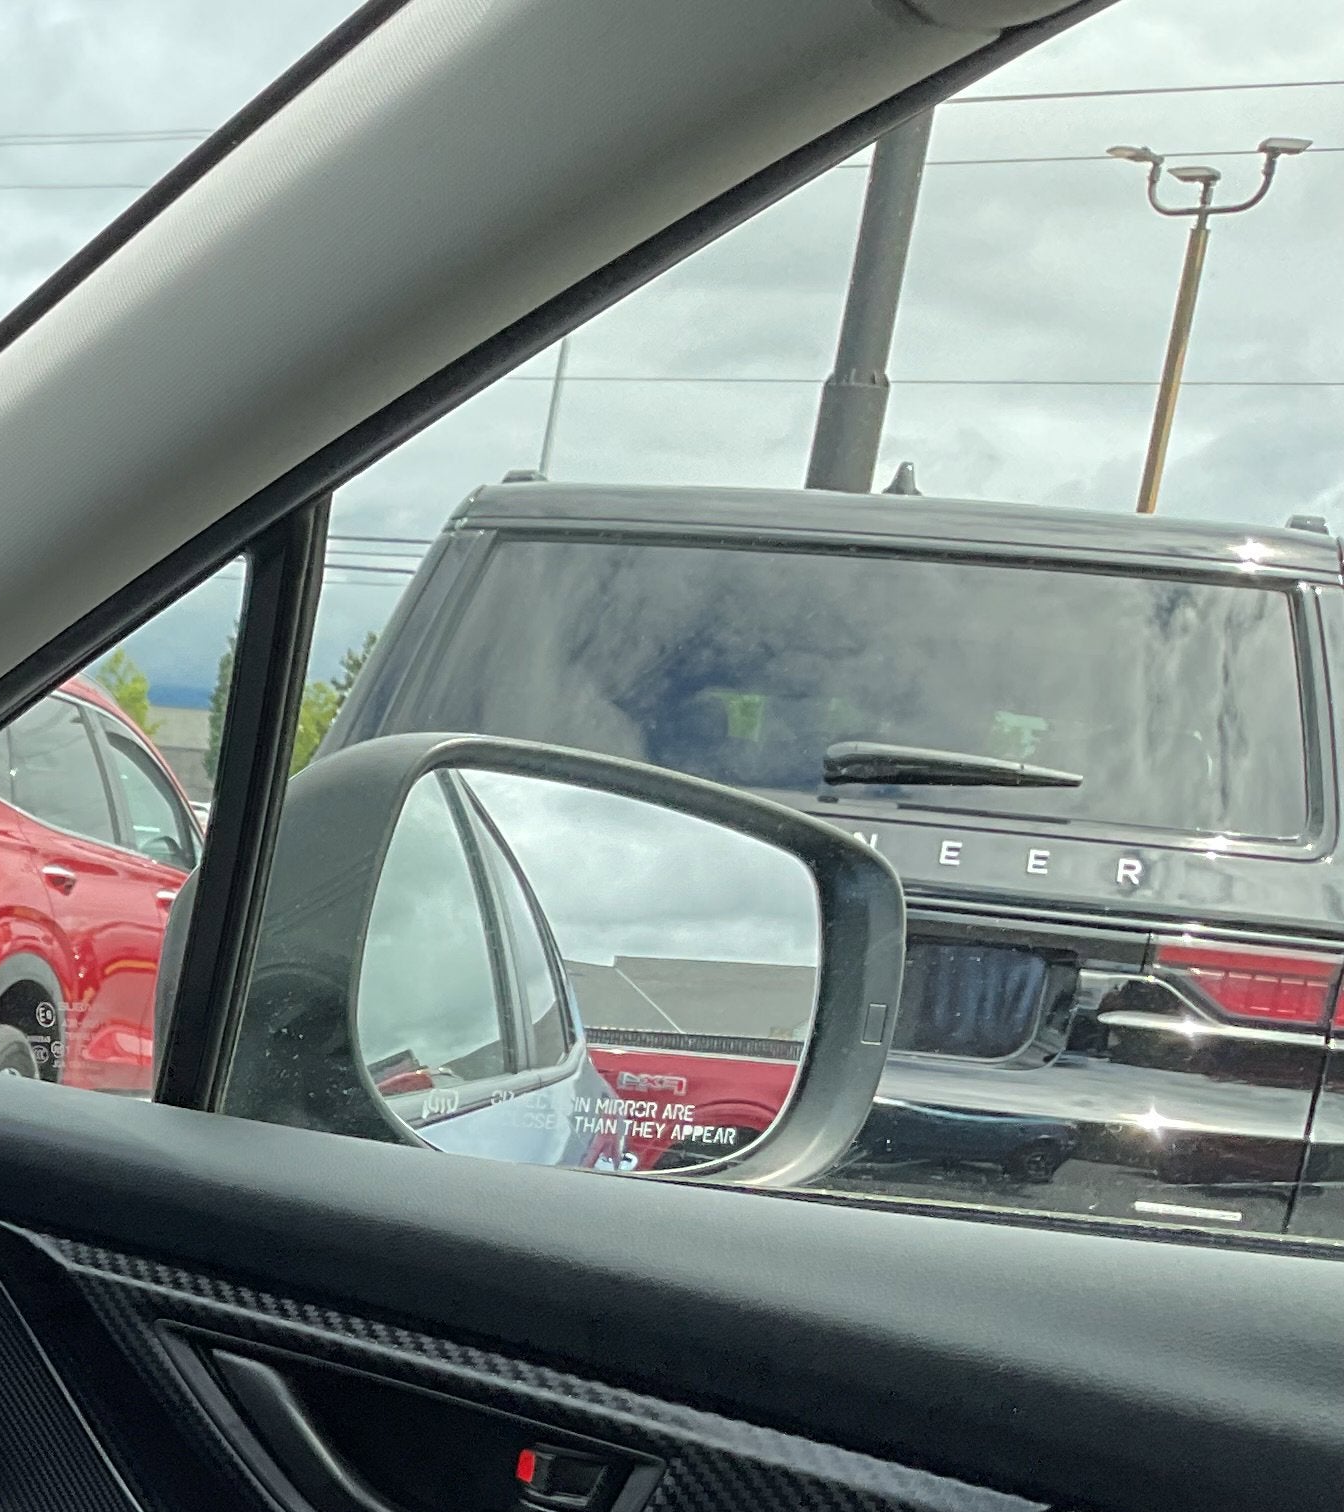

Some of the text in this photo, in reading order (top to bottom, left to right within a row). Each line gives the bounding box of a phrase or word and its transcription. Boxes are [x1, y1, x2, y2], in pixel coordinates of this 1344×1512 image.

[574, 1098, 590, 1113] IN
[595, 1099, 657, 1119] MIRROR
[662, 1103, 696, 1122] ARE
[574, 1116, 617, 1135] THAN
[623, 1119, 665, 1139] THEY
[670, 1124, 736, 1145] APPEAR
